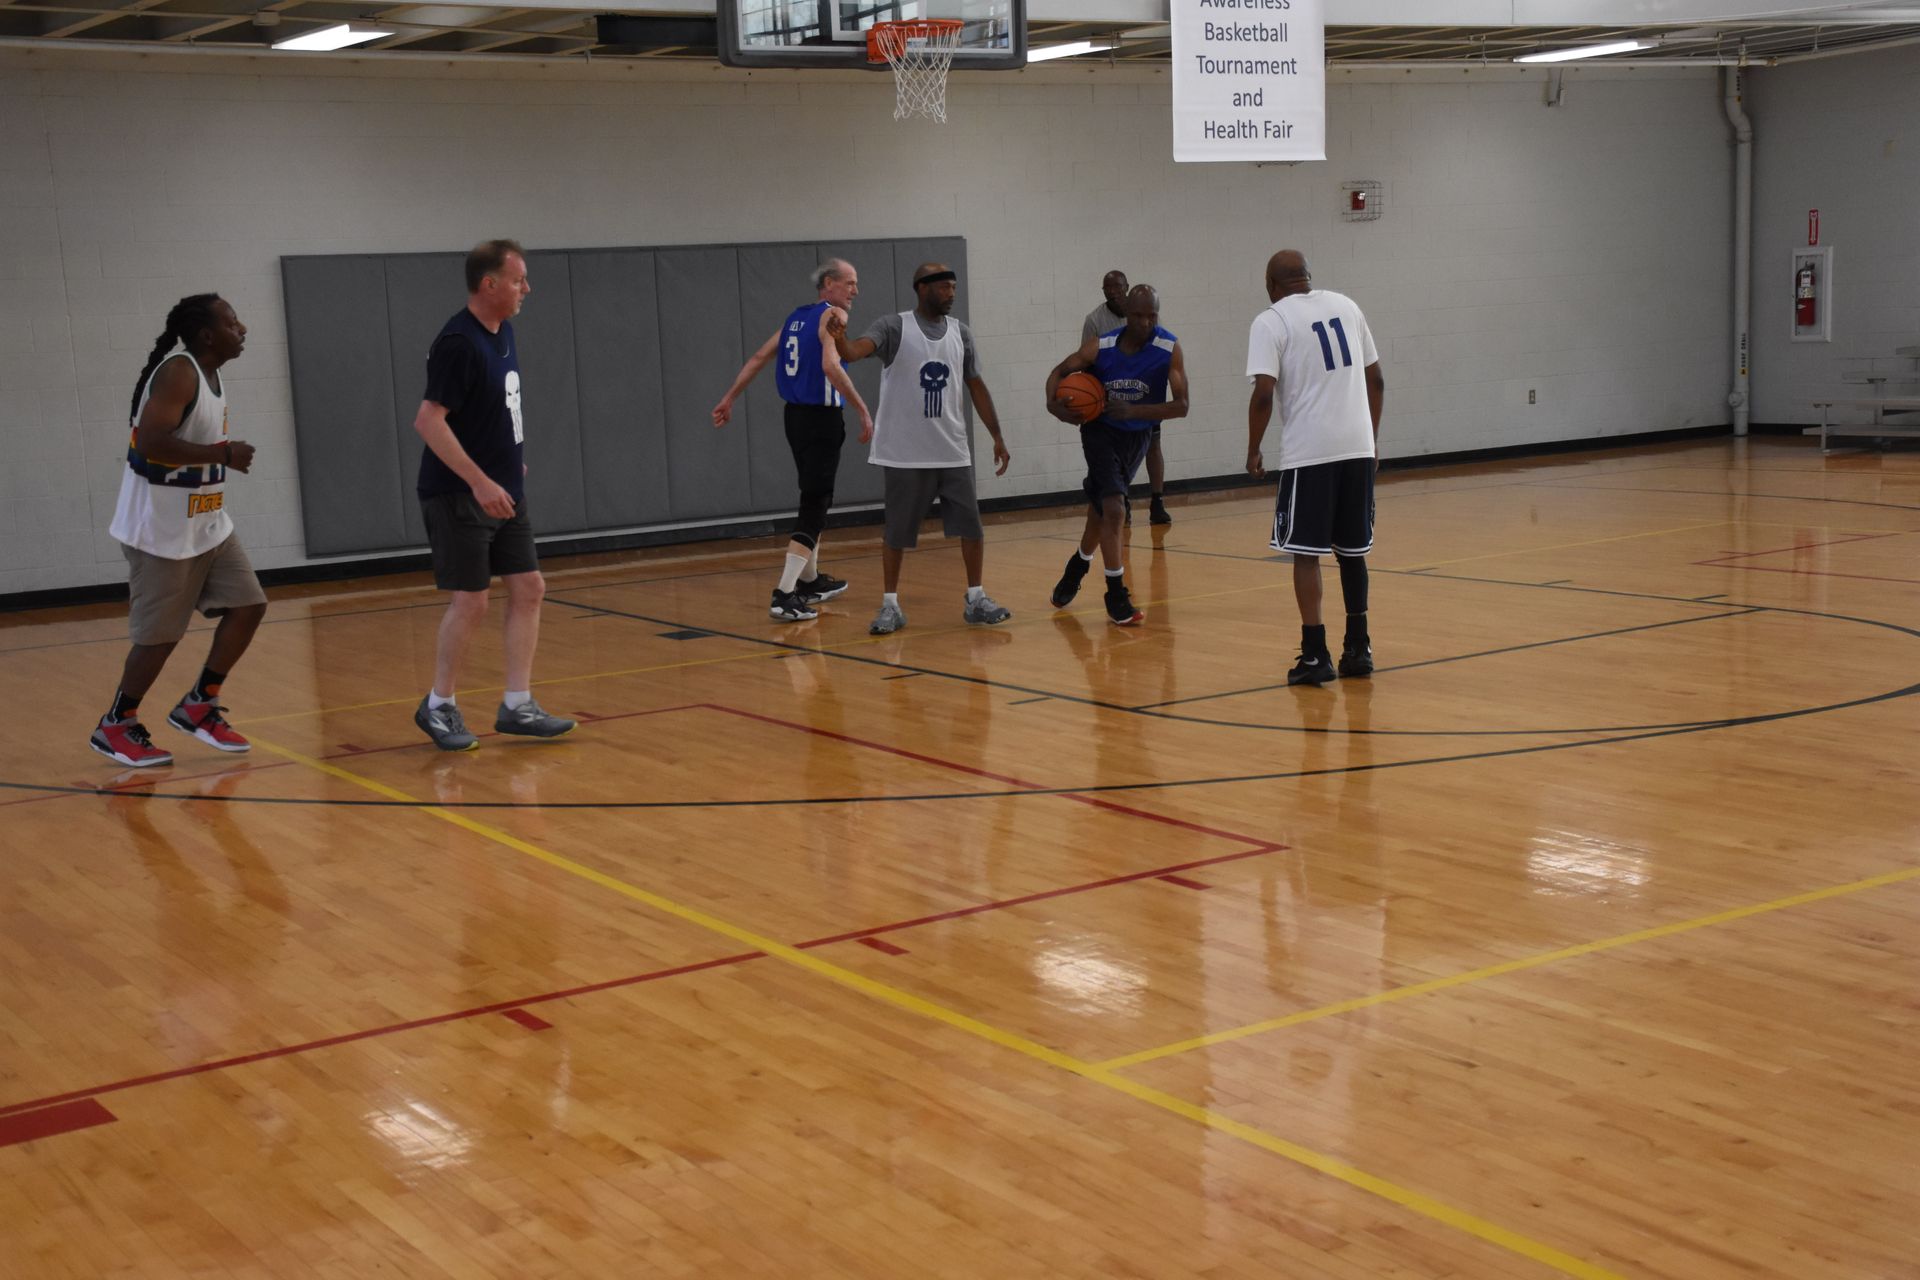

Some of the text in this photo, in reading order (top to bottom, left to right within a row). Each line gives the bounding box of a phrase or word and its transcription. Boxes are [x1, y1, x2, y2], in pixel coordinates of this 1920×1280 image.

[1204, 21, 1288, 42] Basketball
[1195, 55, 1298, 75] Tournament
[1232, 87, 1263, 107] and
[1204, 119, 1294, 139] Health Fair
[1311, 317, 1353, 372] 11
[785, 336, 799, 376] 3
